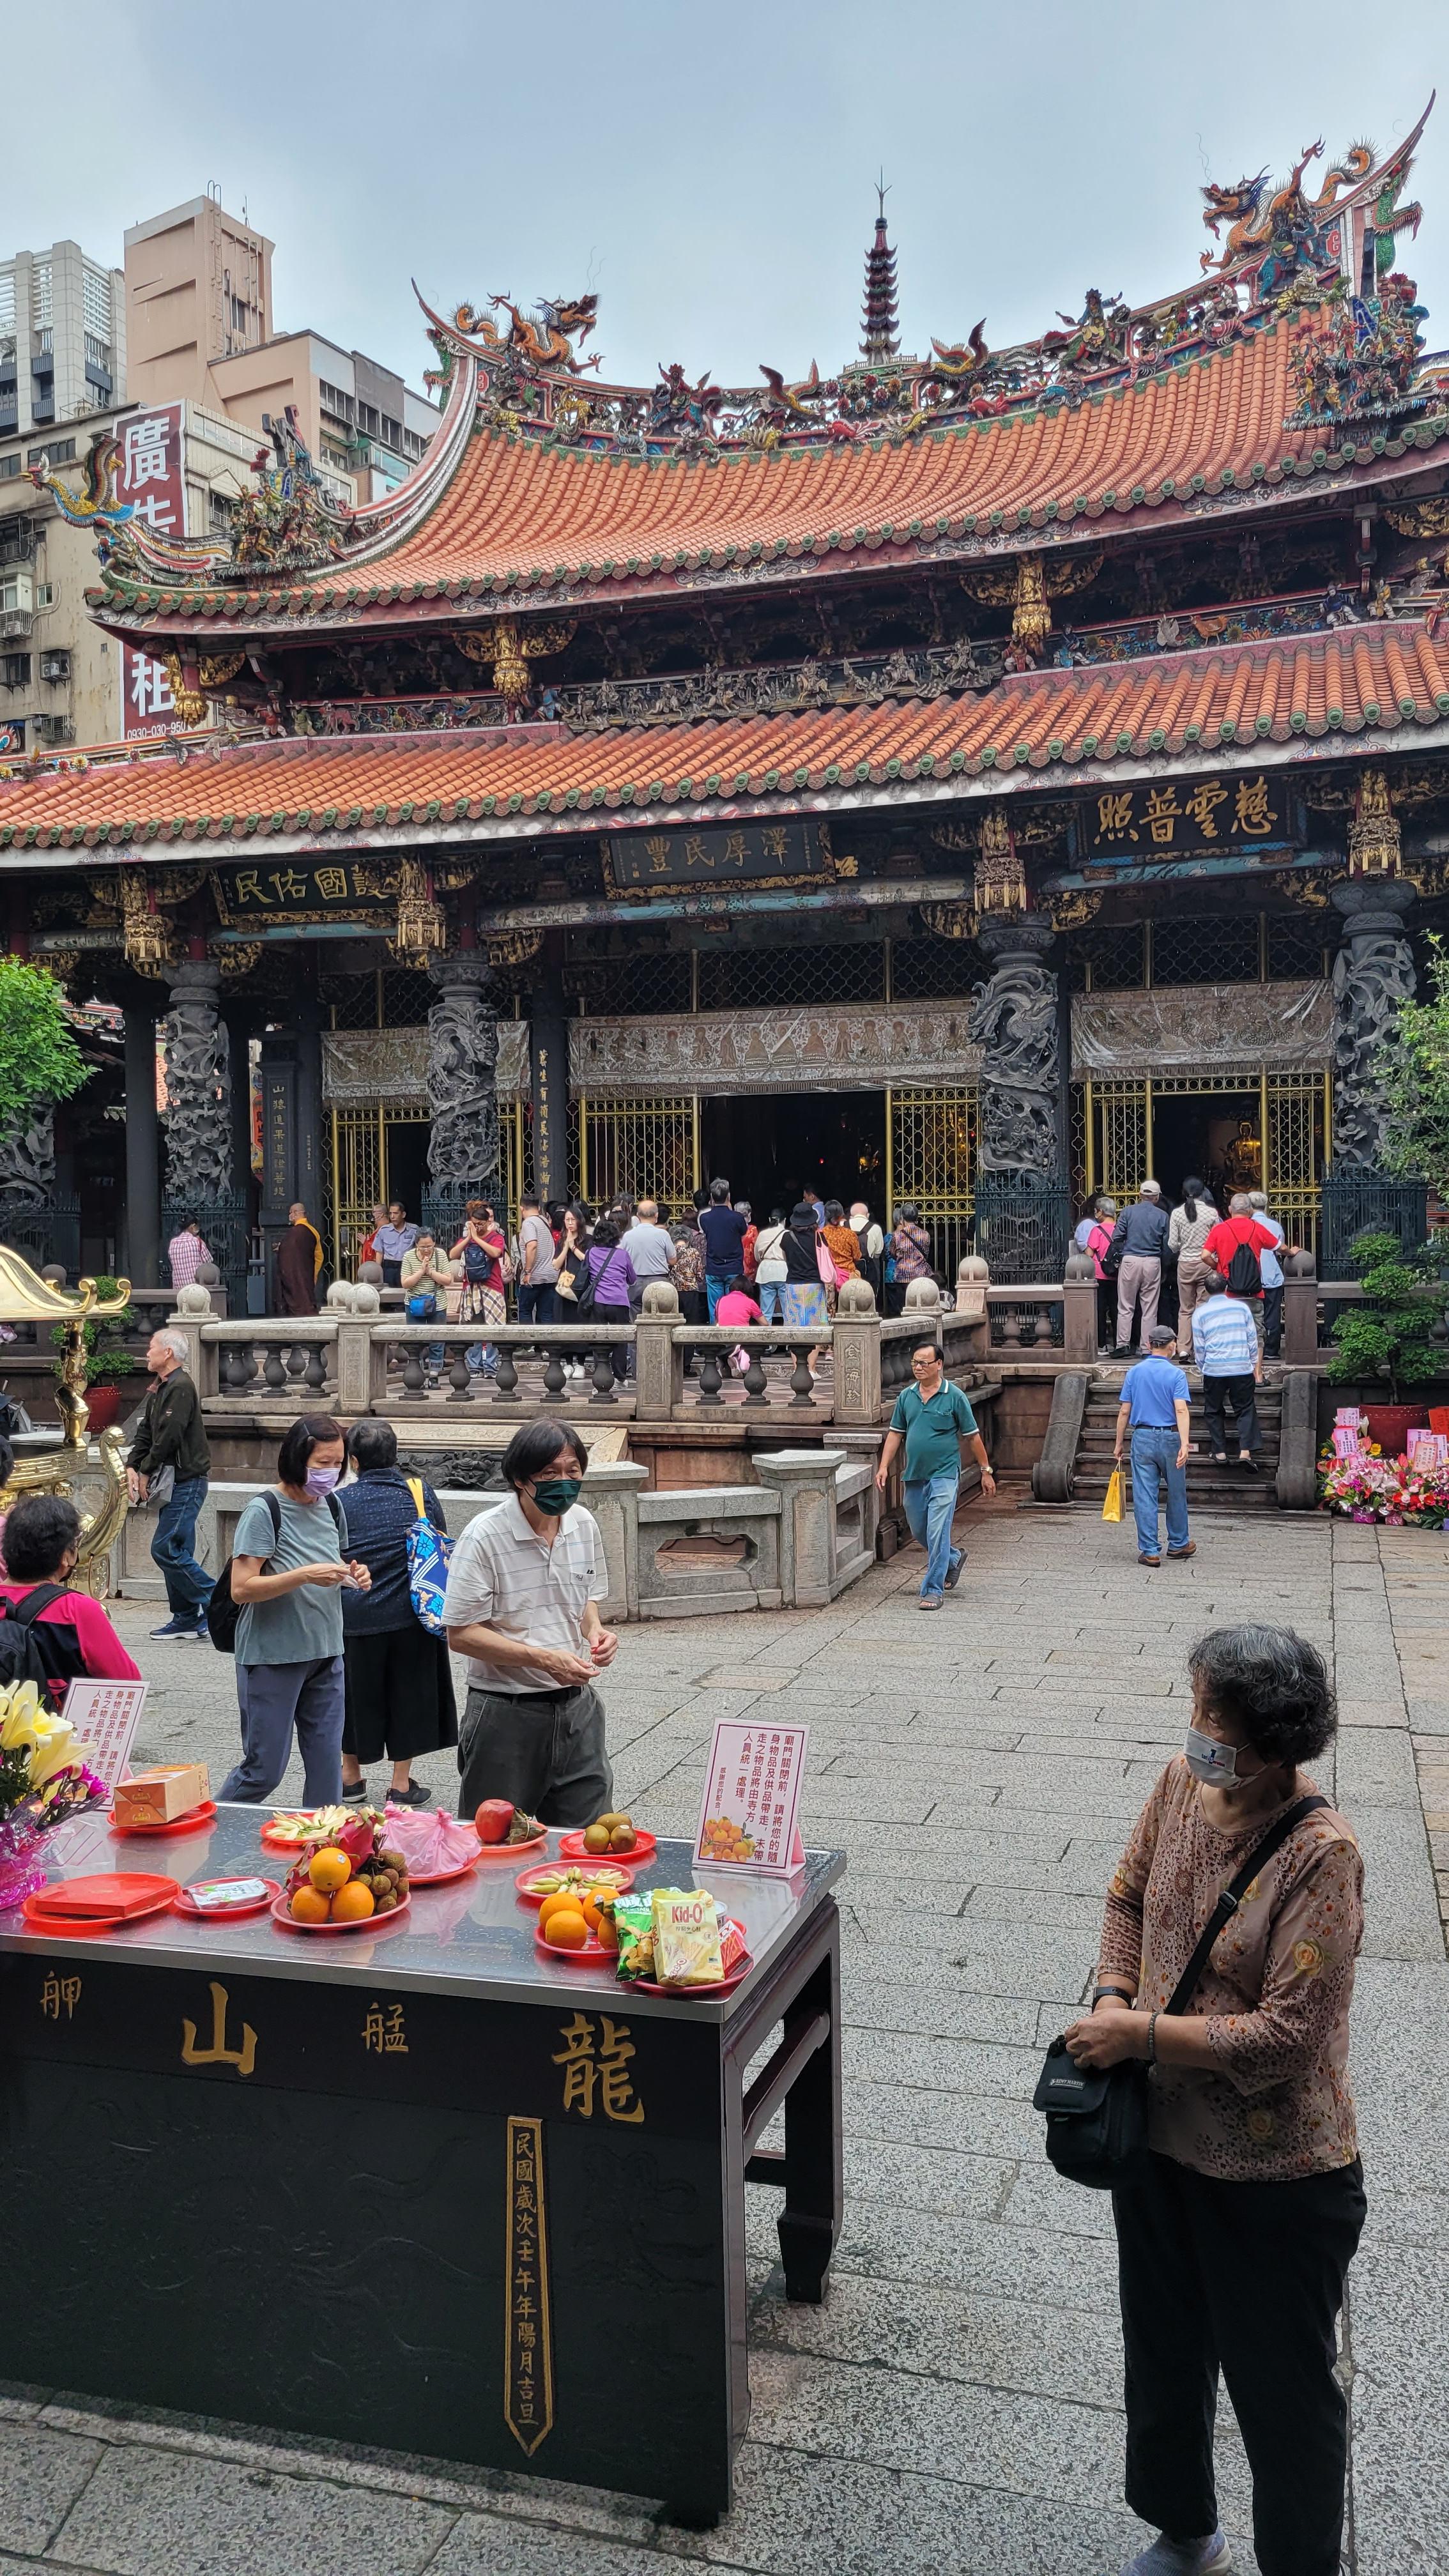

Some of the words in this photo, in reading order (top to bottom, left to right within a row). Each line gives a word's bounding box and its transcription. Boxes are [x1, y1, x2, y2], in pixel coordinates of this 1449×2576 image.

[1094, 776, 1278, 844] 慈雲普照
[671, 1903, 703, 1924] Kid-O
[40, 1970, 82, 2021] 舺
[181, 1981, 258, 2076] 山
[361, 2002, 409, 2053] 艋
[552, 2012, 645, 2123] 龍
[514, 2133, 539, 2425] 民國歲次壬午年陽月吉旦
